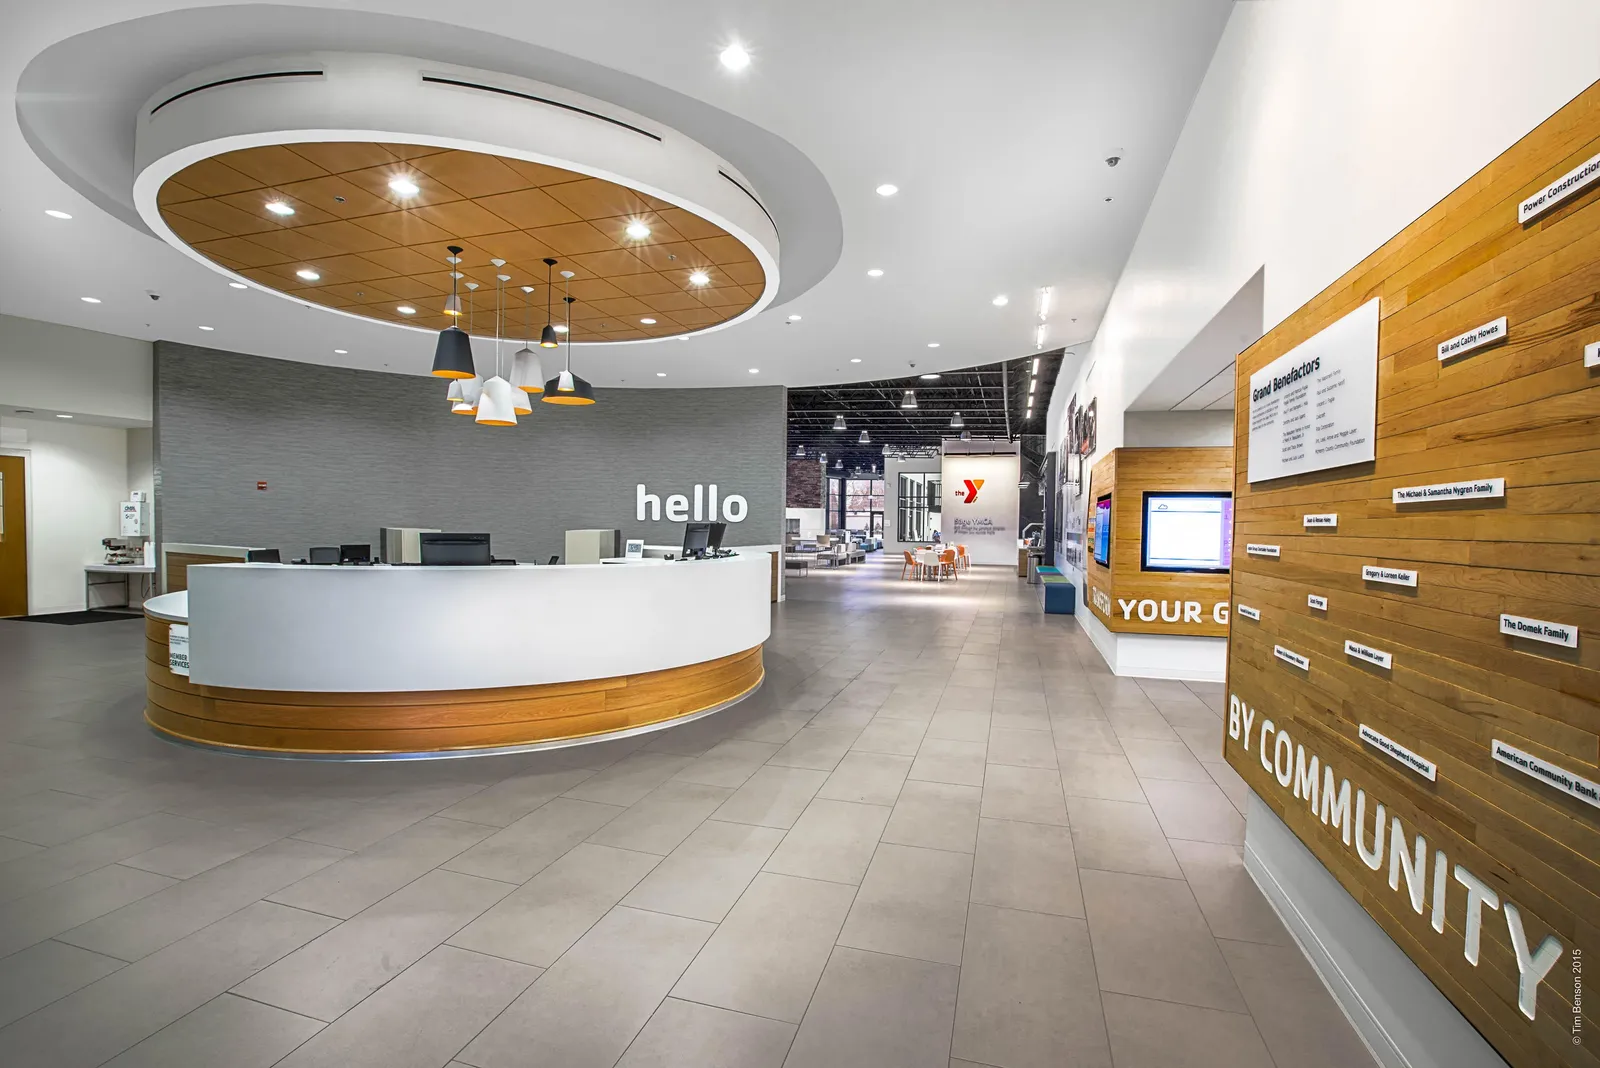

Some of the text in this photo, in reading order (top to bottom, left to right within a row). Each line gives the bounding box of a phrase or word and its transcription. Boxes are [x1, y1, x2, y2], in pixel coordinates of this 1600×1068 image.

[1523, 195, 1546, 214] Power
[1441, 325, 1498, 354] Bill and Cathy Howes
[1253, 380, 1271, 402] Grand
[1273, 356, 1320, 392] Benefactors
[1406, 489, 1422, 498] Michael
[1428, 486, 1452, 496] Samantha
[1453, 485, 1473, 495] Nygren
[1473, 483, 1493, 493] Family
[636, 484, 748, 523] hello
[1366, 569, 1379, 578] Gregory
[1118, 598, 1203, 623] YOUR
[1504, 618, 1569, 642] The Domek Family
[170, 653, 187, 662] MEMBER
[170, 659, 189, 668] SERVICES
[1362, 729, 1430, 773] Advocate Good Shepherd Hospital
[1496, 746, 1598, 800] American Community Bank
[1229, 694, 1563, 1021] BY COMMUNITY
